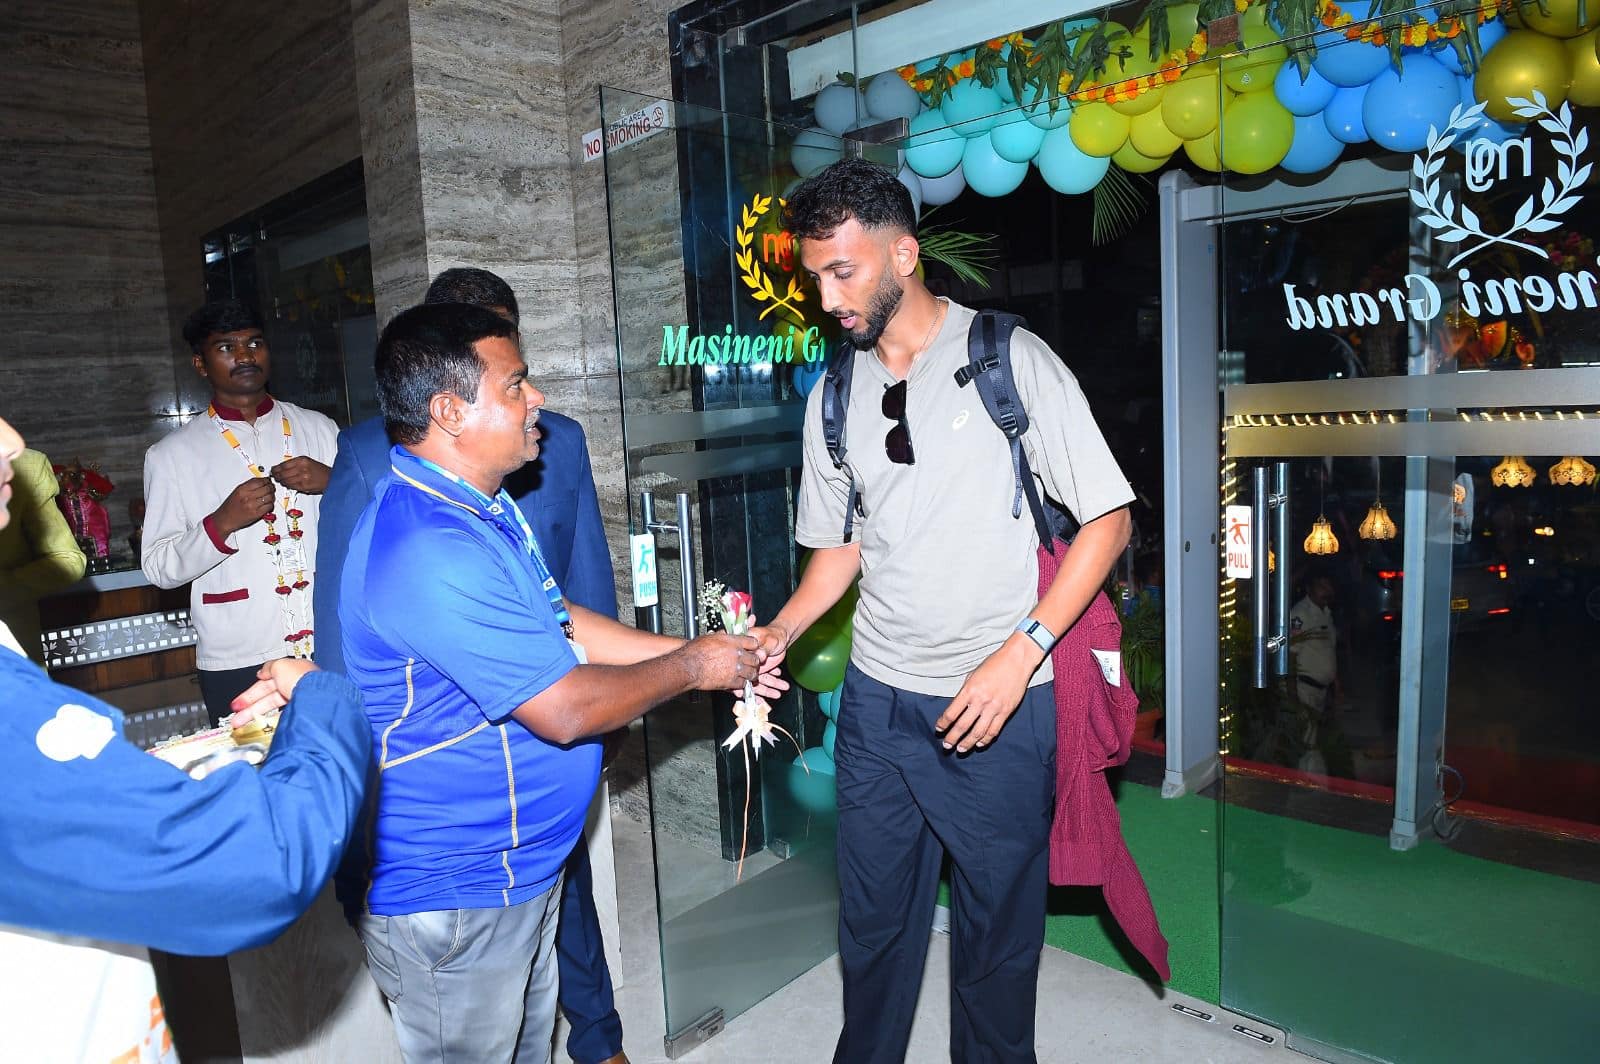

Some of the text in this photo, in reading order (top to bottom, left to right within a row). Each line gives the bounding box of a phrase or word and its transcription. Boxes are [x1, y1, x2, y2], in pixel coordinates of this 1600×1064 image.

[607, 110, 646, 131] UBLIC AREA
[586, 138, 601, 158] NO
[657, 323, 795, 367] Masineni
[1228, 552, 1249, 569] PULL
[639, 581, 657, 599] PUSH
